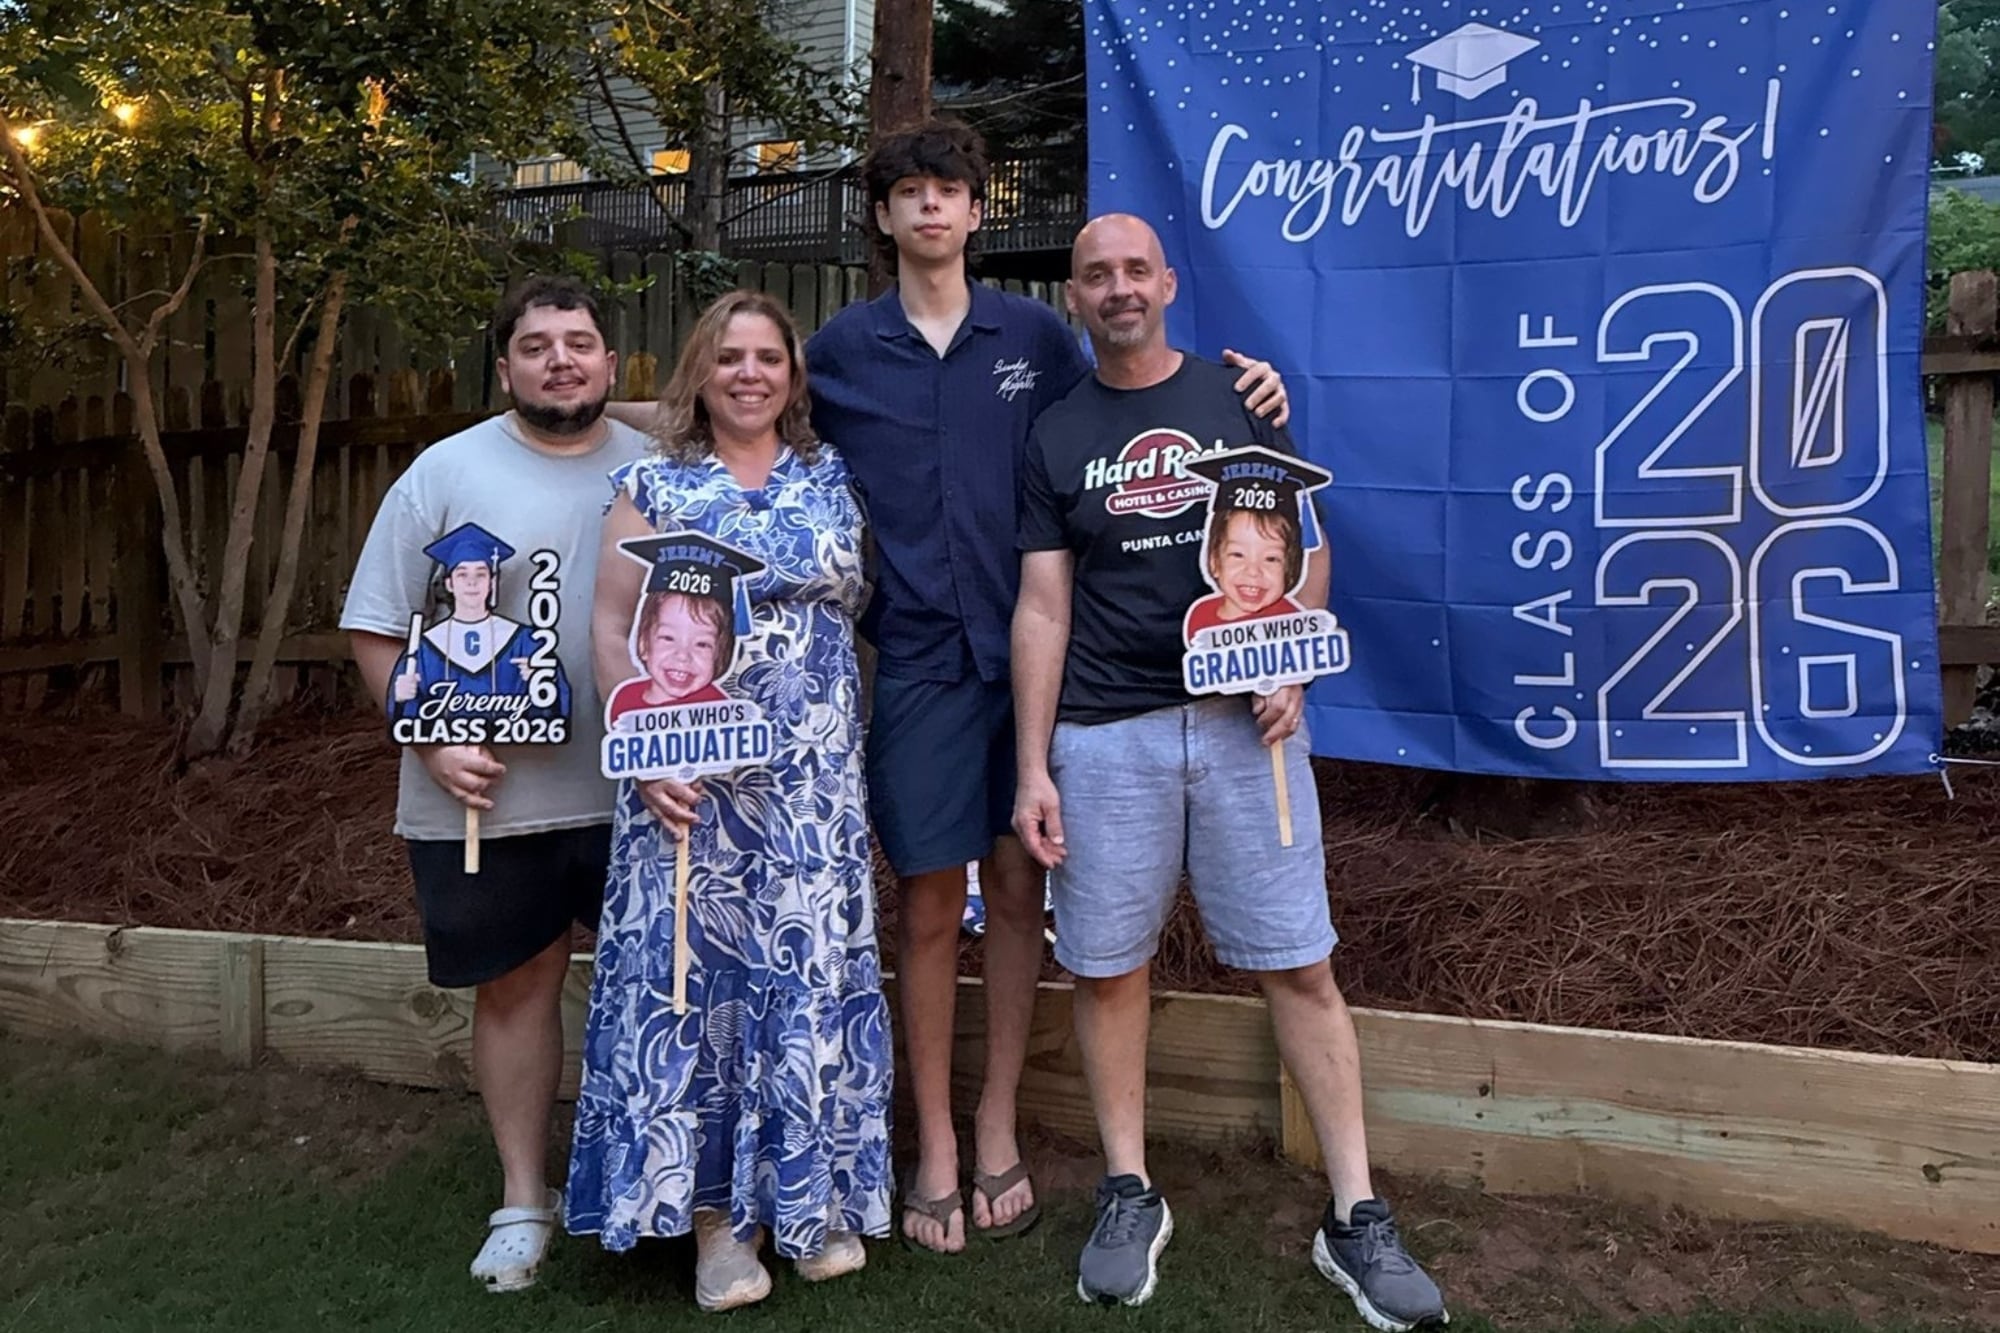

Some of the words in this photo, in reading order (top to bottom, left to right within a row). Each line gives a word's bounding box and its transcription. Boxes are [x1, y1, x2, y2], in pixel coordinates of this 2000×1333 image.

[1200, 78, 1781, 242] Congratulations!
[1516, 313, 1578, 422] OF
[1084, 447, 1158, 490] Hard
[1221, 462, 1289, 483] JEREMY
[1114, 494, 1155, 509] HOTEL
[1234, 487, 1276, 509] 2026
[1121, 535, 1173, 552] PUNTA
[1175, 529, 1206, 545] CAN
[657, 545, 726, 567] JEREMY
[668, 569, 712, 594] 2026
[1512, 471, 1577, 749] CLASS
[463, 630, 481, 656] C
[530, 551, 560, 708] 2026
[1211, 625, 1262, 648] LOOK
[1263, 616, 1319, 640] WHO'S
[1188, 633, 1345, 688] GRADUATED
[419, 681, 532, 721] Jeremy
[393, 718, 487, 743] CLASS
[493, 718, 566, 743] 2026
[635, 708, 682, 732] LOOK
[689, 705, 745, 727] WHO'S
[607, 723, 770, 773] GRADUATED
